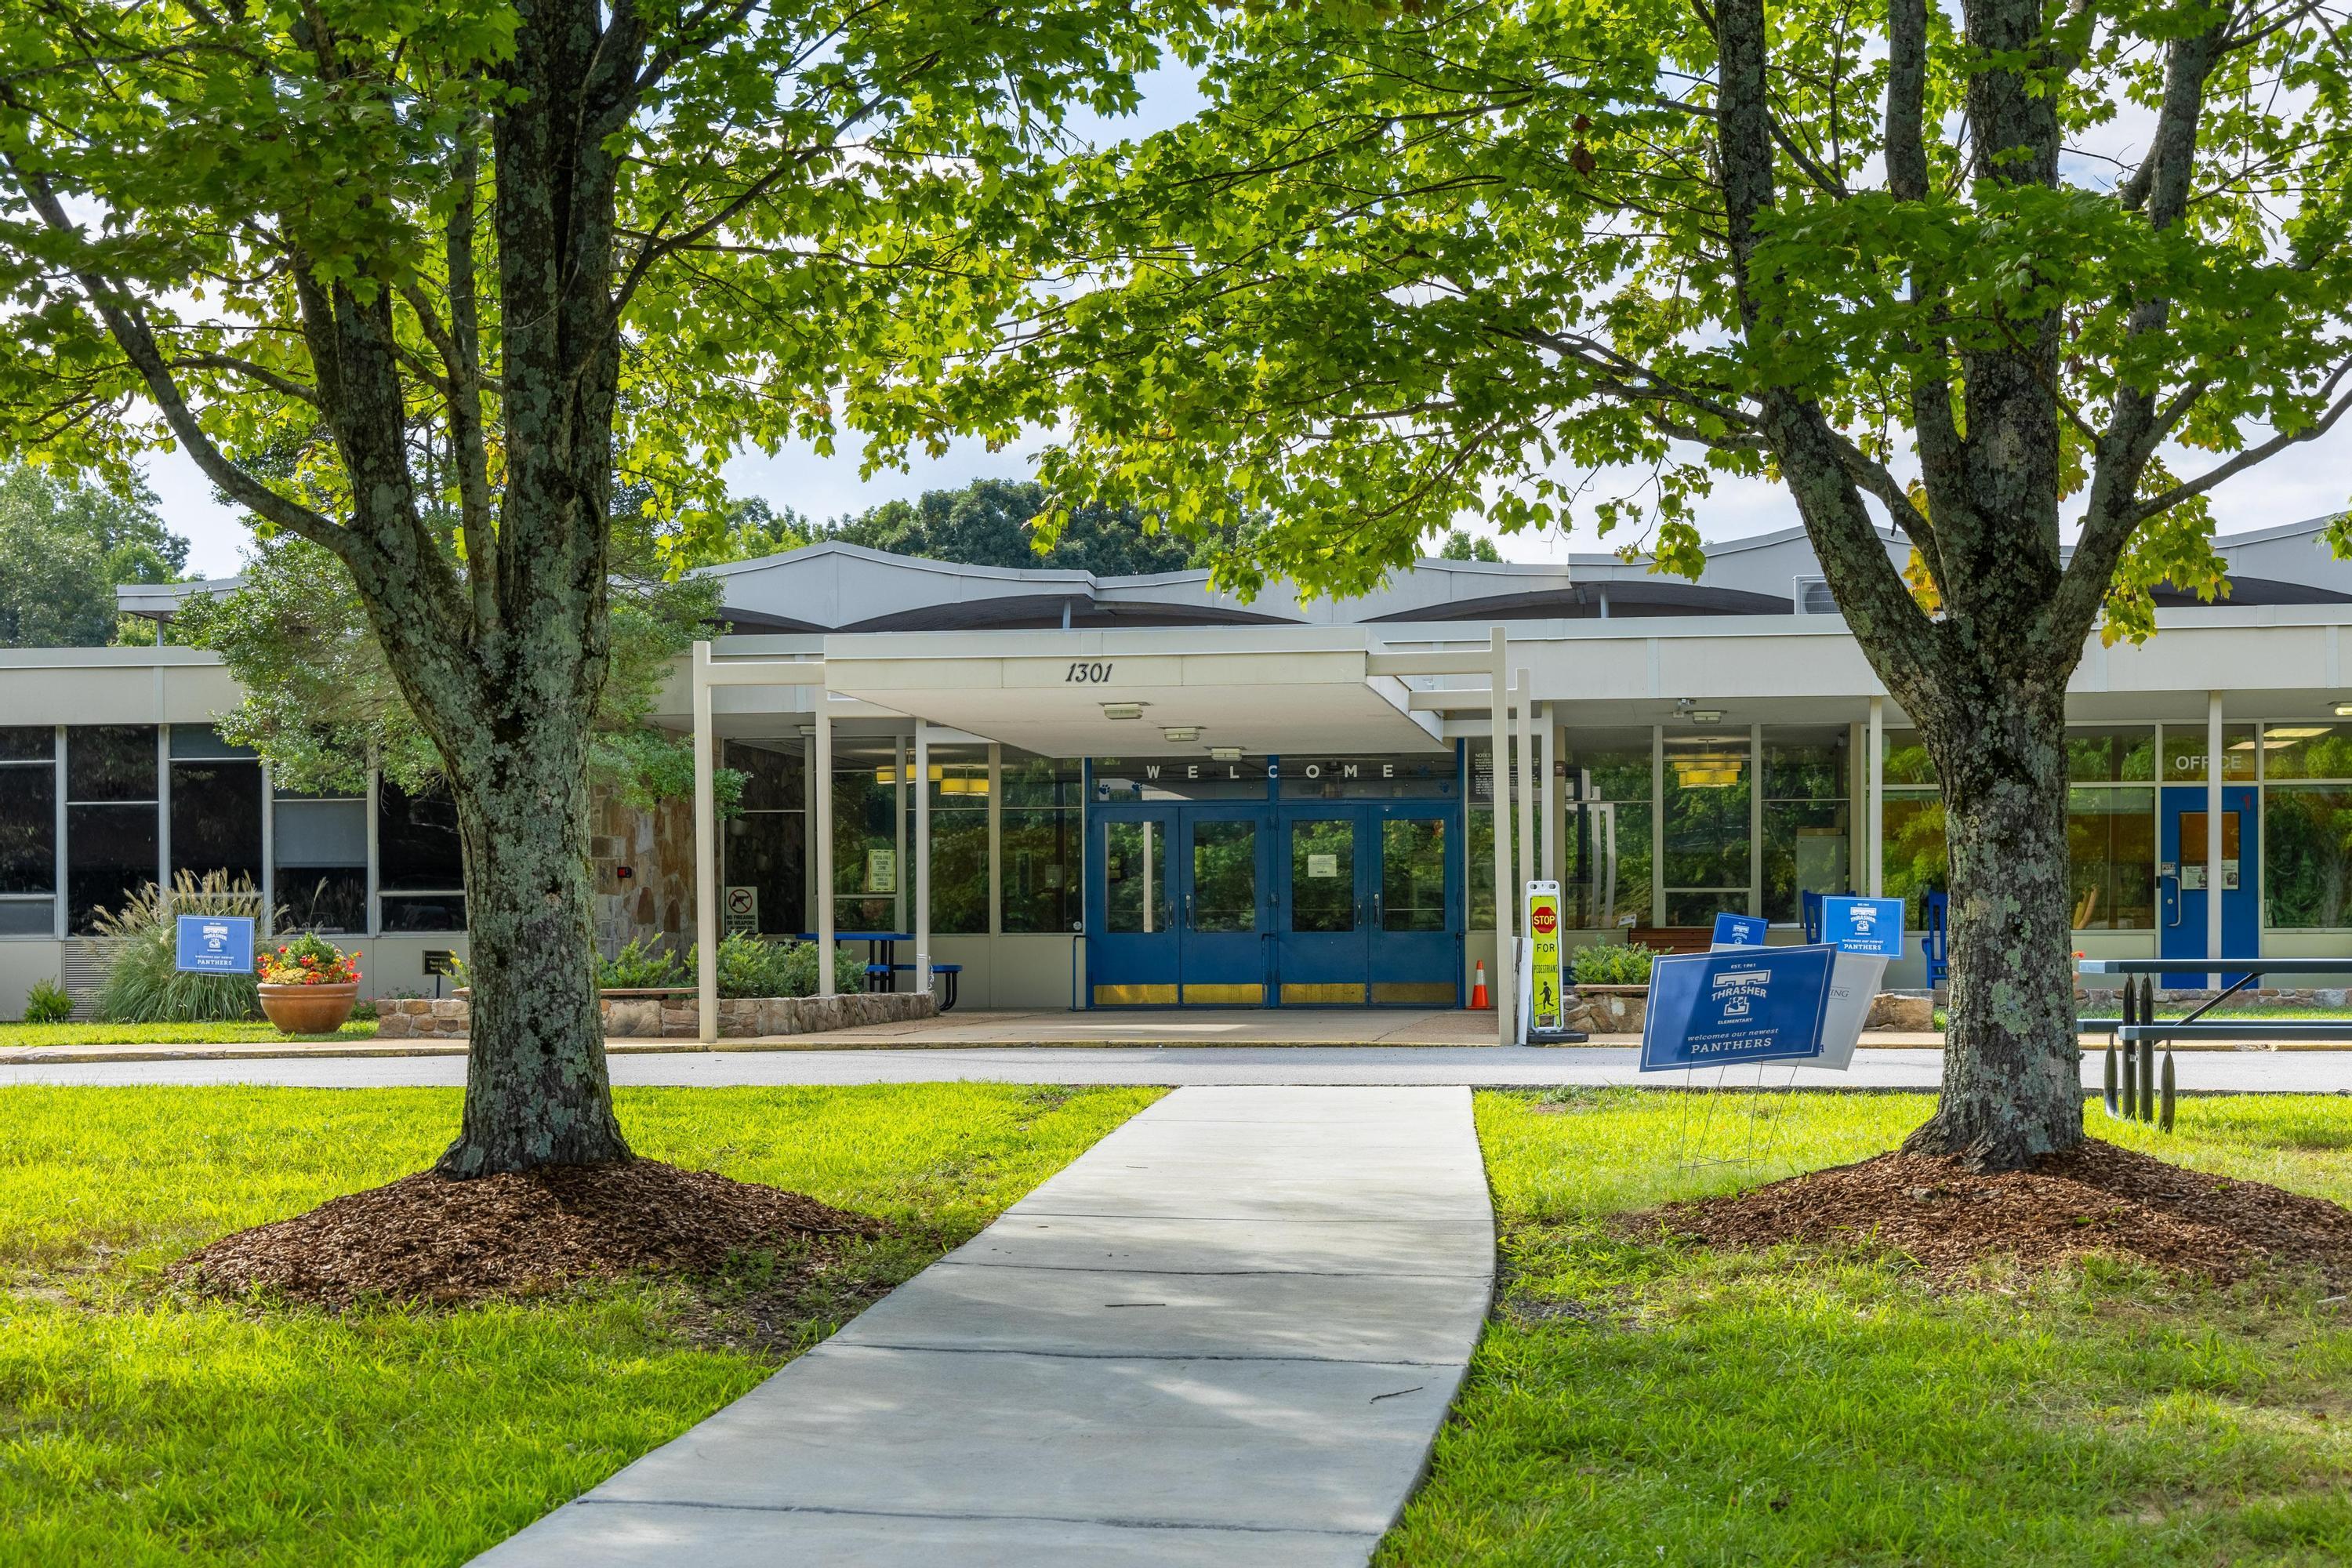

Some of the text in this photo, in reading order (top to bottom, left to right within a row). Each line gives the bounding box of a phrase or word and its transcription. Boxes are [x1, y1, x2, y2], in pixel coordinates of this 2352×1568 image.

[1065, 662, 1113, 684] 1301
[2176, 755, 2241, 770] OFFCE
[1146, 764, 1393, 779] WELCOME
[1534, 916, 1555, 925] STOP
[1537, 943, 1555, 953] FOR
[1534, 964, 1558, 974] PEDESTRIANS
[1711, 985, 1767, 1001] THRASHER
[1687, 1033, 1730, 1041] welcomes
[1690, 1037, 1772, 1054] PANTHERS
